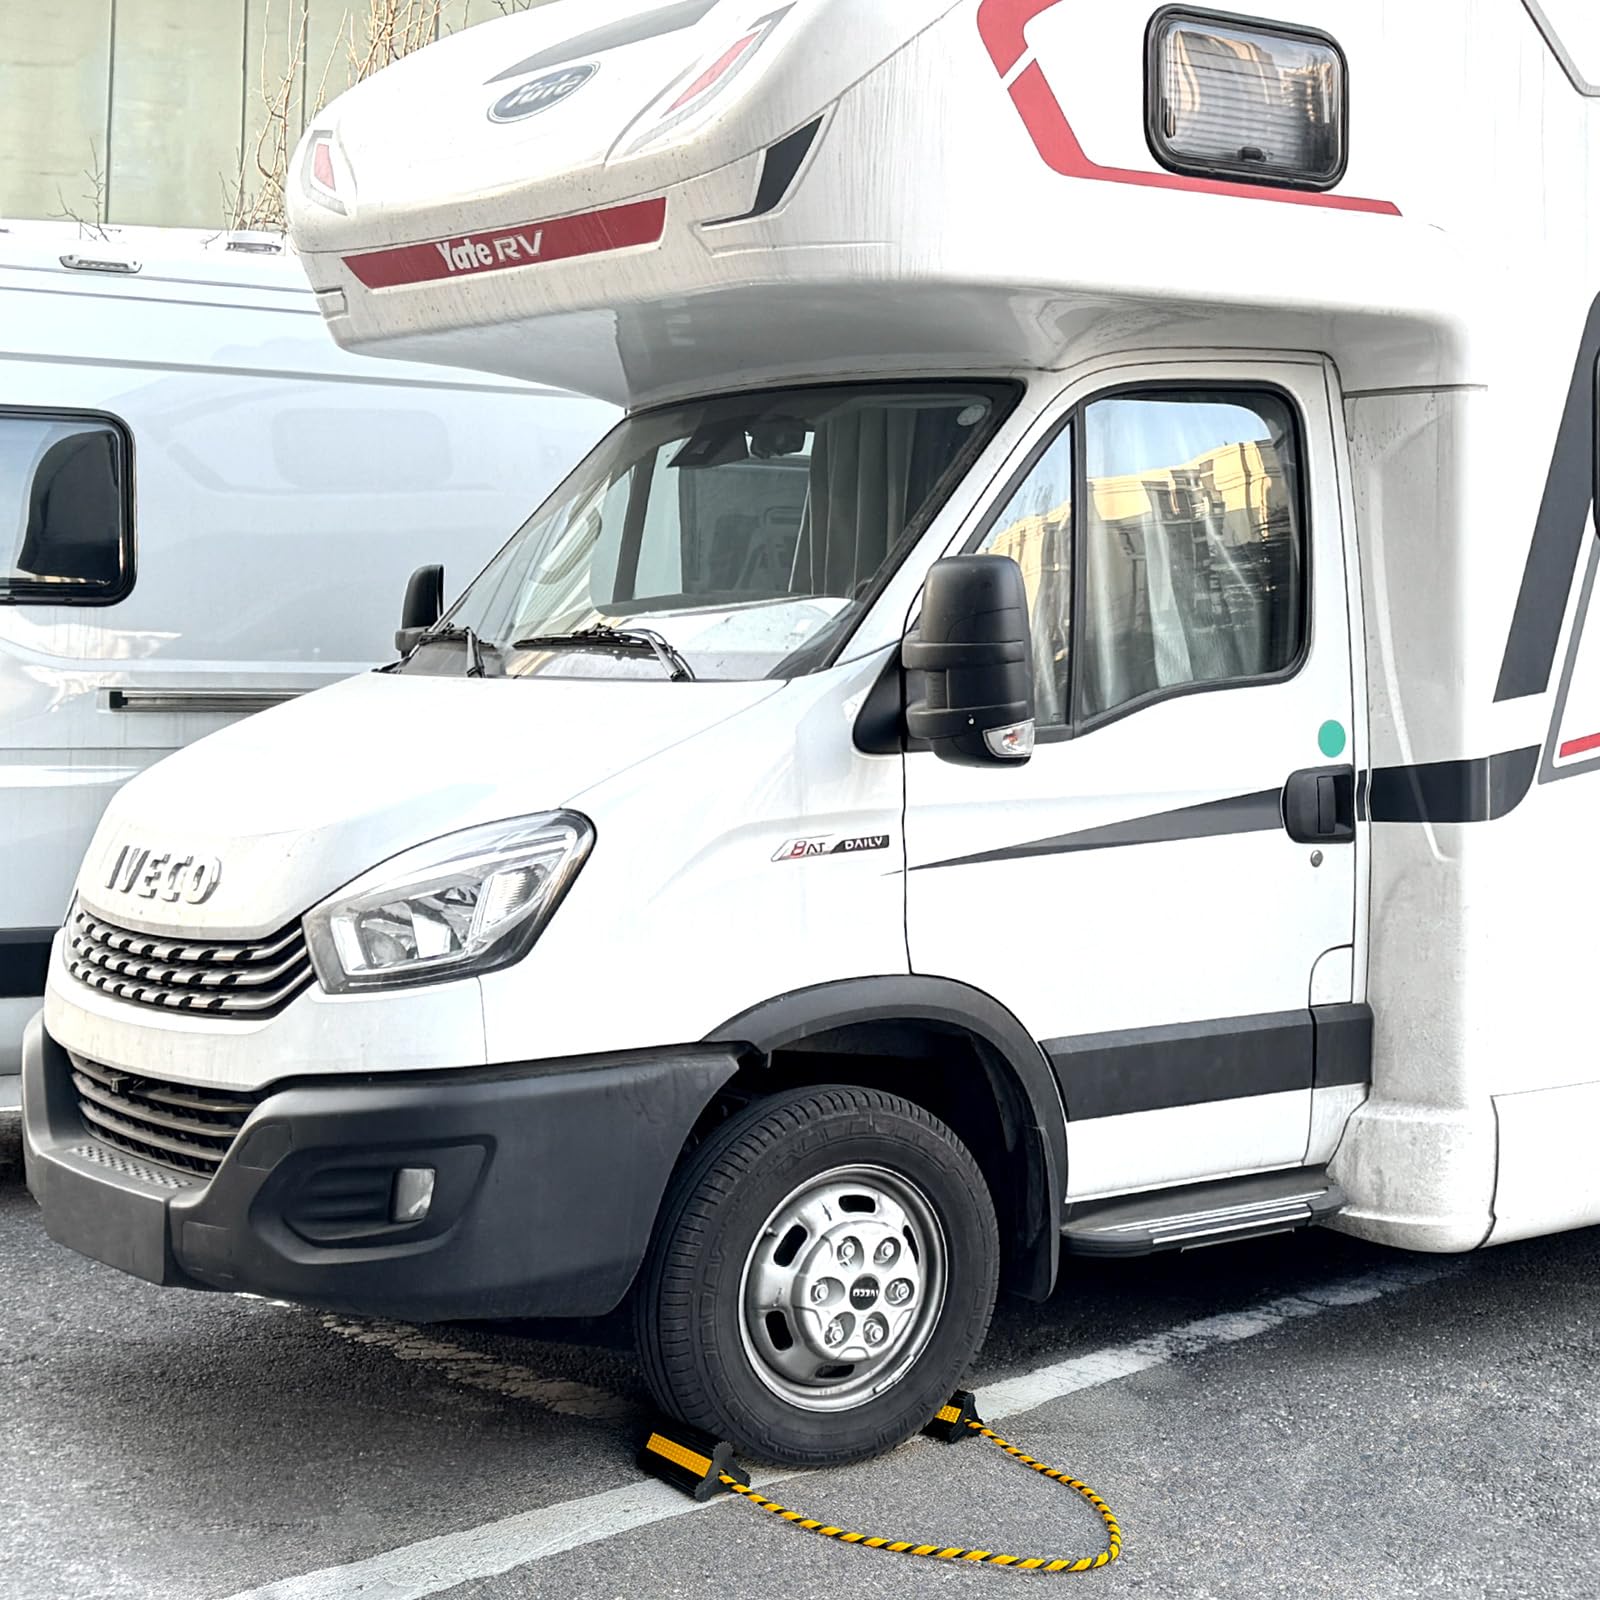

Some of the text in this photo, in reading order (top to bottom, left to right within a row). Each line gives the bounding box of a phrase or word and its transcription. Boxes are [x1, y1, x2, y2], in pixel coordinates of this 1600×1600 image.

[435, 230, 543, 272] Yate RV
[845, 836, 883, 850] DAILY
[104, 845, 222, 905] IVECO
